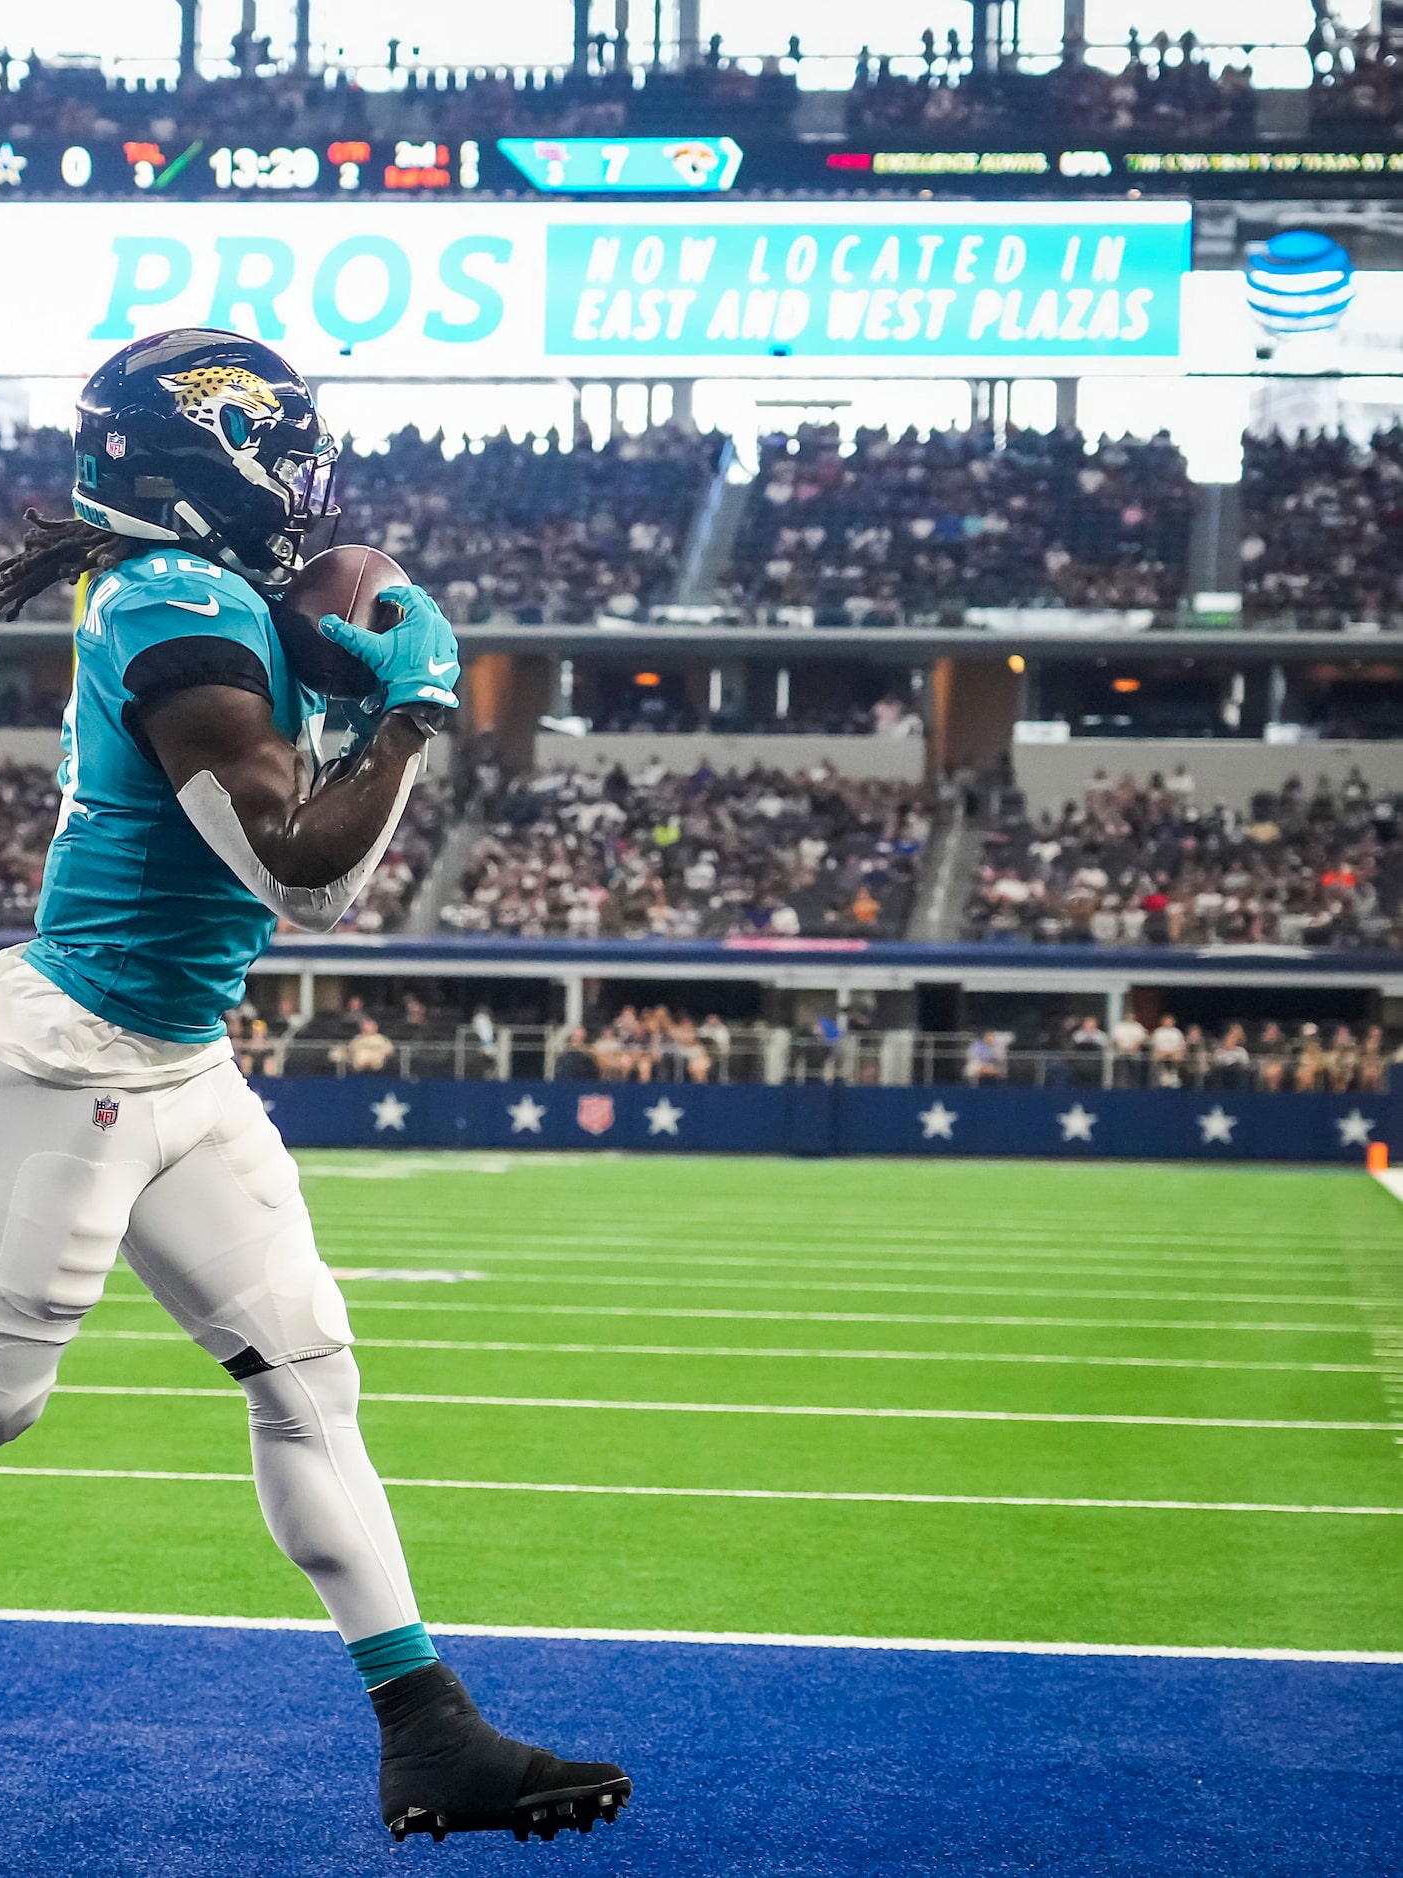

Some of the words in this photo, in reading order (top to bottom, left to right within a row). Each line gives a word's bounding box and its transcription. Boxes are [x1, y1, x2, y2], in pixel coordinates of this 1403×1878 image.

[62, 147, 92, 186] 0
[601, 146, 630, 183] 7
[586, 235, 716, 284] NOW
[747, 235, 1026, 284] LOCATED
[1061, 236, 1125, 283] IN
[90, 235, 513, 343] PROS
[573, 290, 697, 341] EAST
[706, 290, 810, 341] AND
[826, 290, 957, 341] WEST
[968, 289, 1154, 341] PLAZAS
[109, 443, 123, 455] NFL
[98, 1110, 116, 1123] NFL
